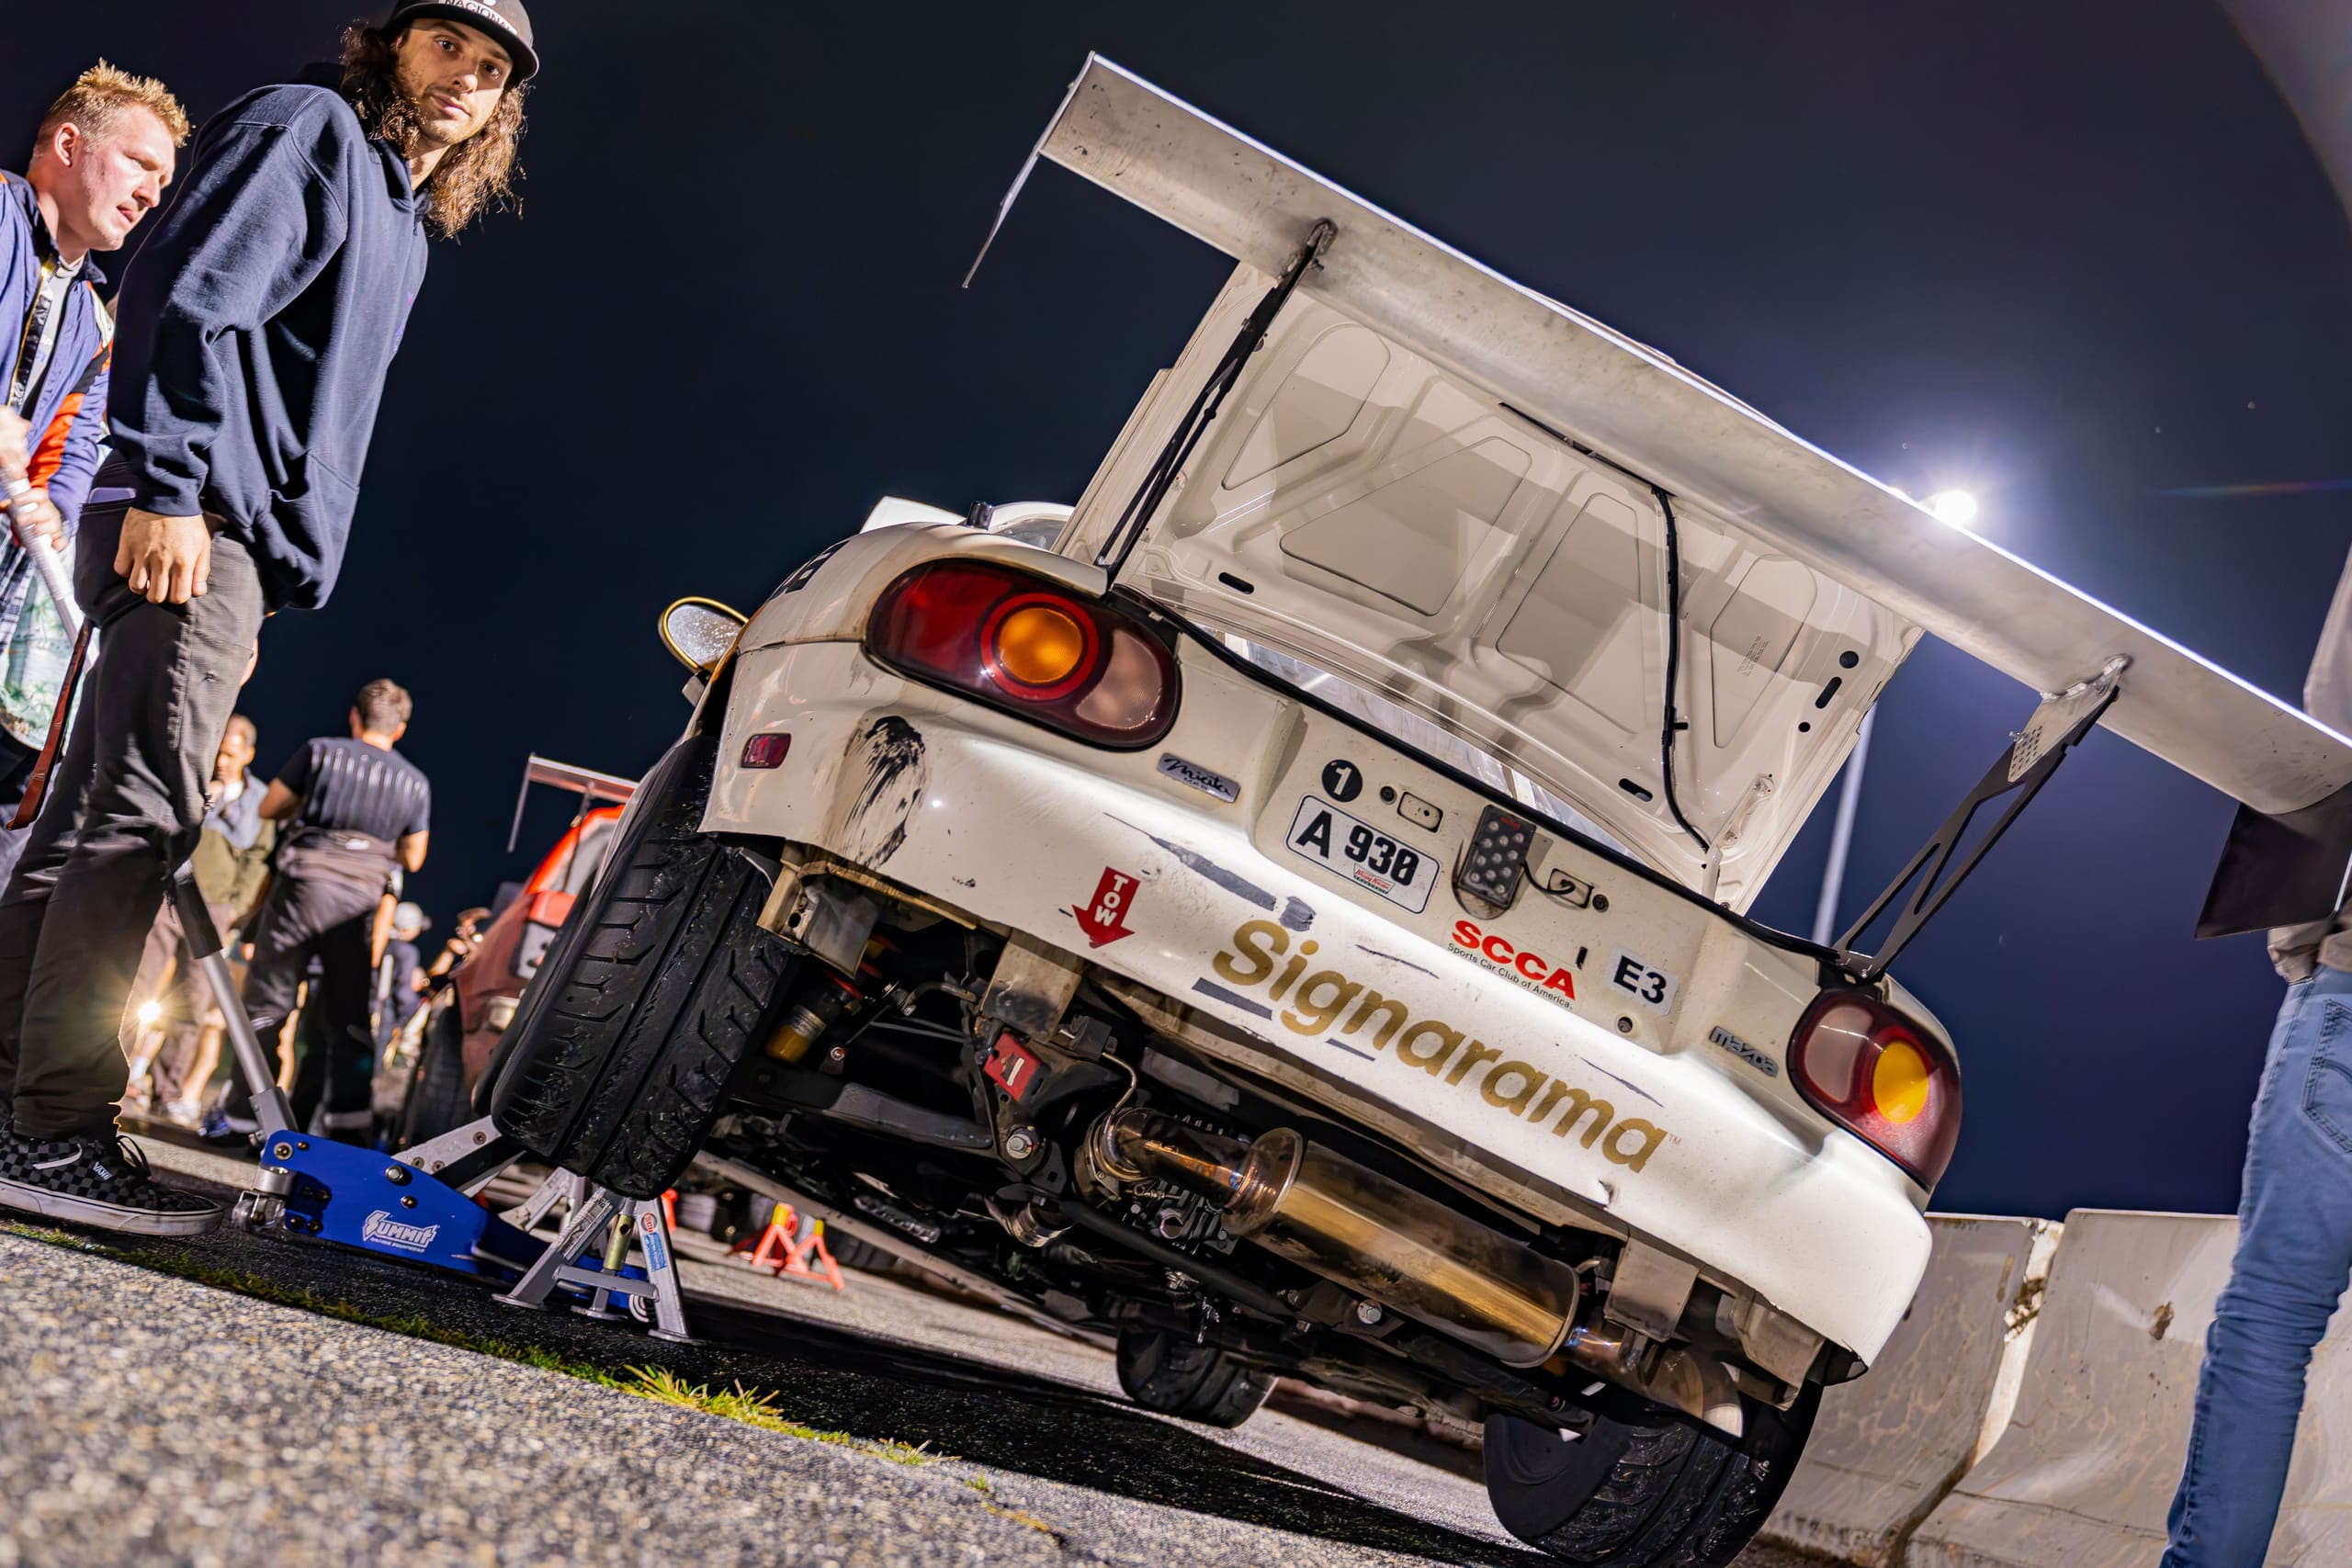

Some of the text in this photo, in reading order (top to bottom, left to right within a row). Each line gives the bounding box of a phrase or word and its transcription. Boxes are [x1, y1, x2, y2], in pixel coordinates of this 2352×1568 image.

[1164, 758, 1233, 795] Miata
[1334, 767, 1352, 795] 1
[1295, 809, 1332, 860] A
[1094, 874, 1129, 927] TOW
[1447, 942, 1477, 964] Sports
[1480, 958, 1496, 972] Car
[1498, 967, 1520, 984] Club
[1521, 979, 1532, 988] of
[1452, 919, 1576, 1000] SCCA
[1612, 954, 1668, 1005] E3
[1213, 920, 1668, 1172] Signarama
[1709, 1025, 1779, 1078] mazda
